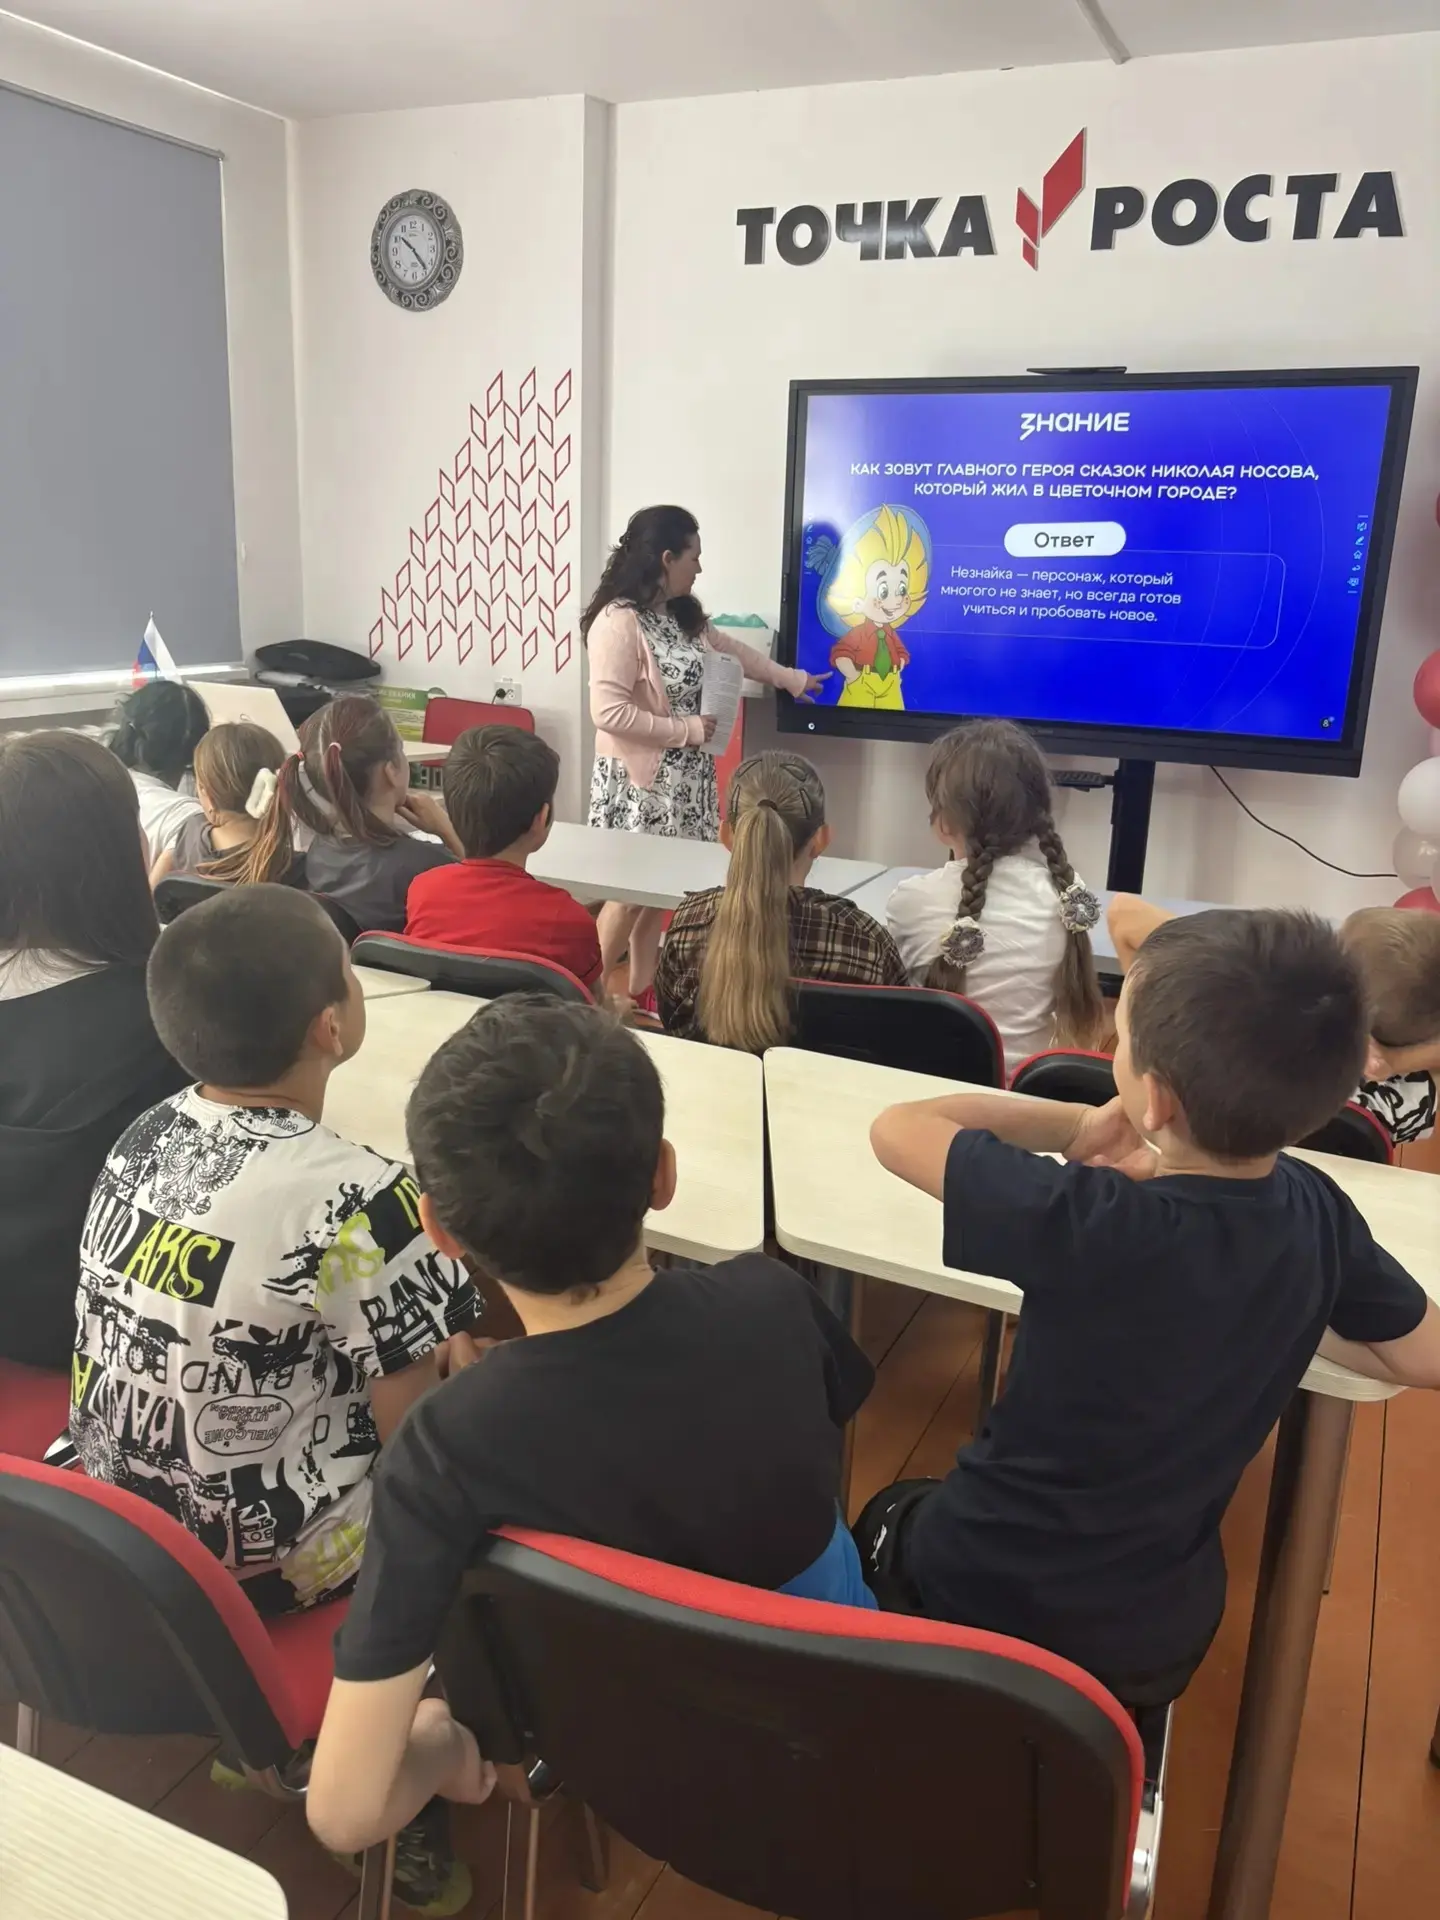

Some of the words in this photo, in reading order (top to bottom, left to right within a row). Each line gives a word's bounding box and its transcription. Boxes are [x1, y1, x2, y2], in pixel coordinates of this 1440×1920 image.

[736, 194, 998, 267] ТОЧКА
[1090, 171, 1407, 251] РОСТА
[850, 463, 880, 476] КАК
[884, 463, 933, 476] ЗОВУТ
[937, 463, 1017, 476] ГЛАВНОГО
[1022, 464, 1074, 477] ГЕРОЯ
[1080, 464, 1147, 478] СКАЗОК
[1151, 465, 1234, 478] НИКОЛАЯ
[1240, 465, 1320, 481] НОСОВА,
[914, 481, 987, 496] КОТОРЫЙ
[991, 484, 1028, 496] ЖИЛ
[1033, 484, 1044, 497] В
[1049, 484, 1152, 499] ЦВЕТОЧНОМ
[1158, 486, 1237, 501] ГОРОДЕ?
[1034, 532, 1095, 548] Ответ
[951, 565, 1013, 580] Незнайка
[1032, 570, 1106, 585] персонаж,
[1109, 572, 1174, 587] который
[940, 585, 996, 598] многого
[1000, 586, 1017, 598] не
[1020, 588, 1061, 601] знает,
[1065, 589, 1083, 601] но
[1086, 591, 1136, 604] всегда
[1140, 593, 1182, 605] готов
[962, 604, 1016, 616] учиться
[1019, 605, 1028, 616] и
[1031, 604, 1106, 620] пробовать
[1109, 610, 1158, 622] новое.
